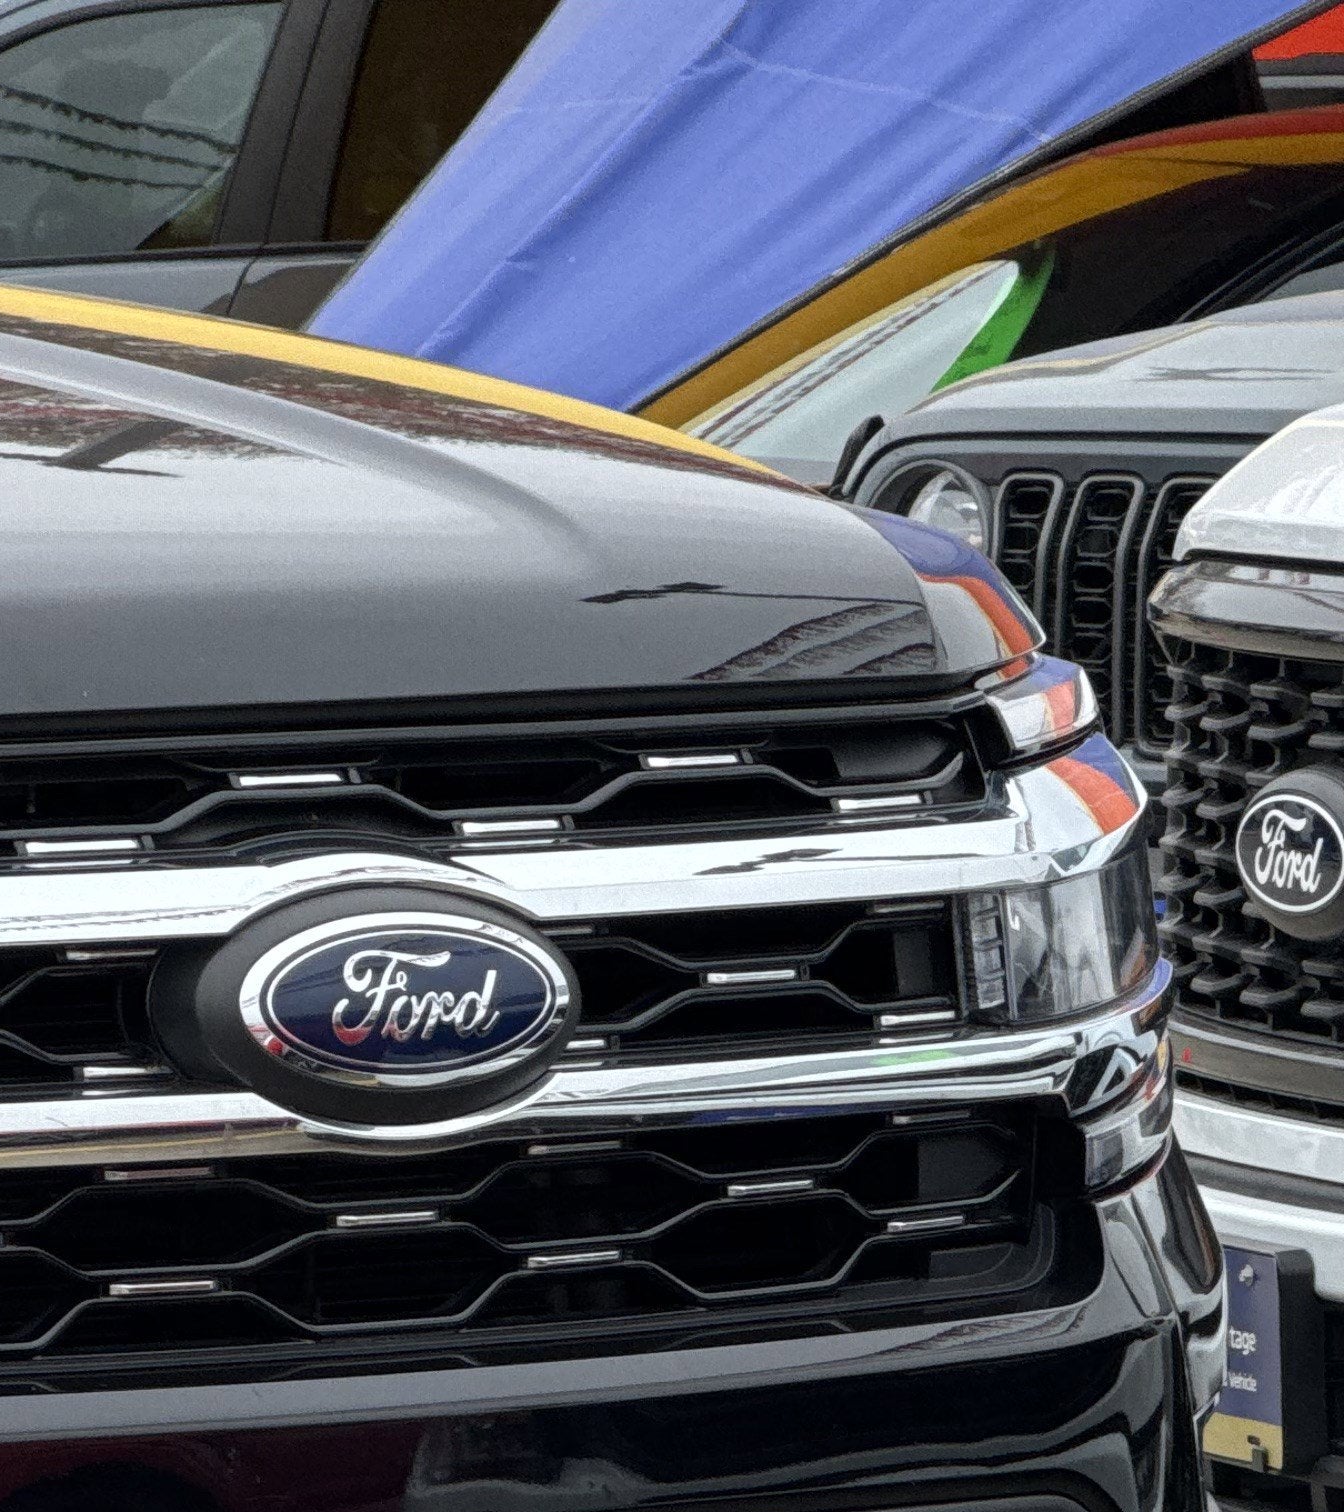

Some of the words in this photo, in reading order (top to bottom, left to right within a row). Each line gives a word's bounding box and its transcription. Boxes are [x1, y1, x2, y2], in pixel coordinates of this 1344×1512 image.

[1253, 808, 1324, 893] Ford
[332, 949, 501, 1047] Ford
[1229, 1326, 1256, 1355] tage
